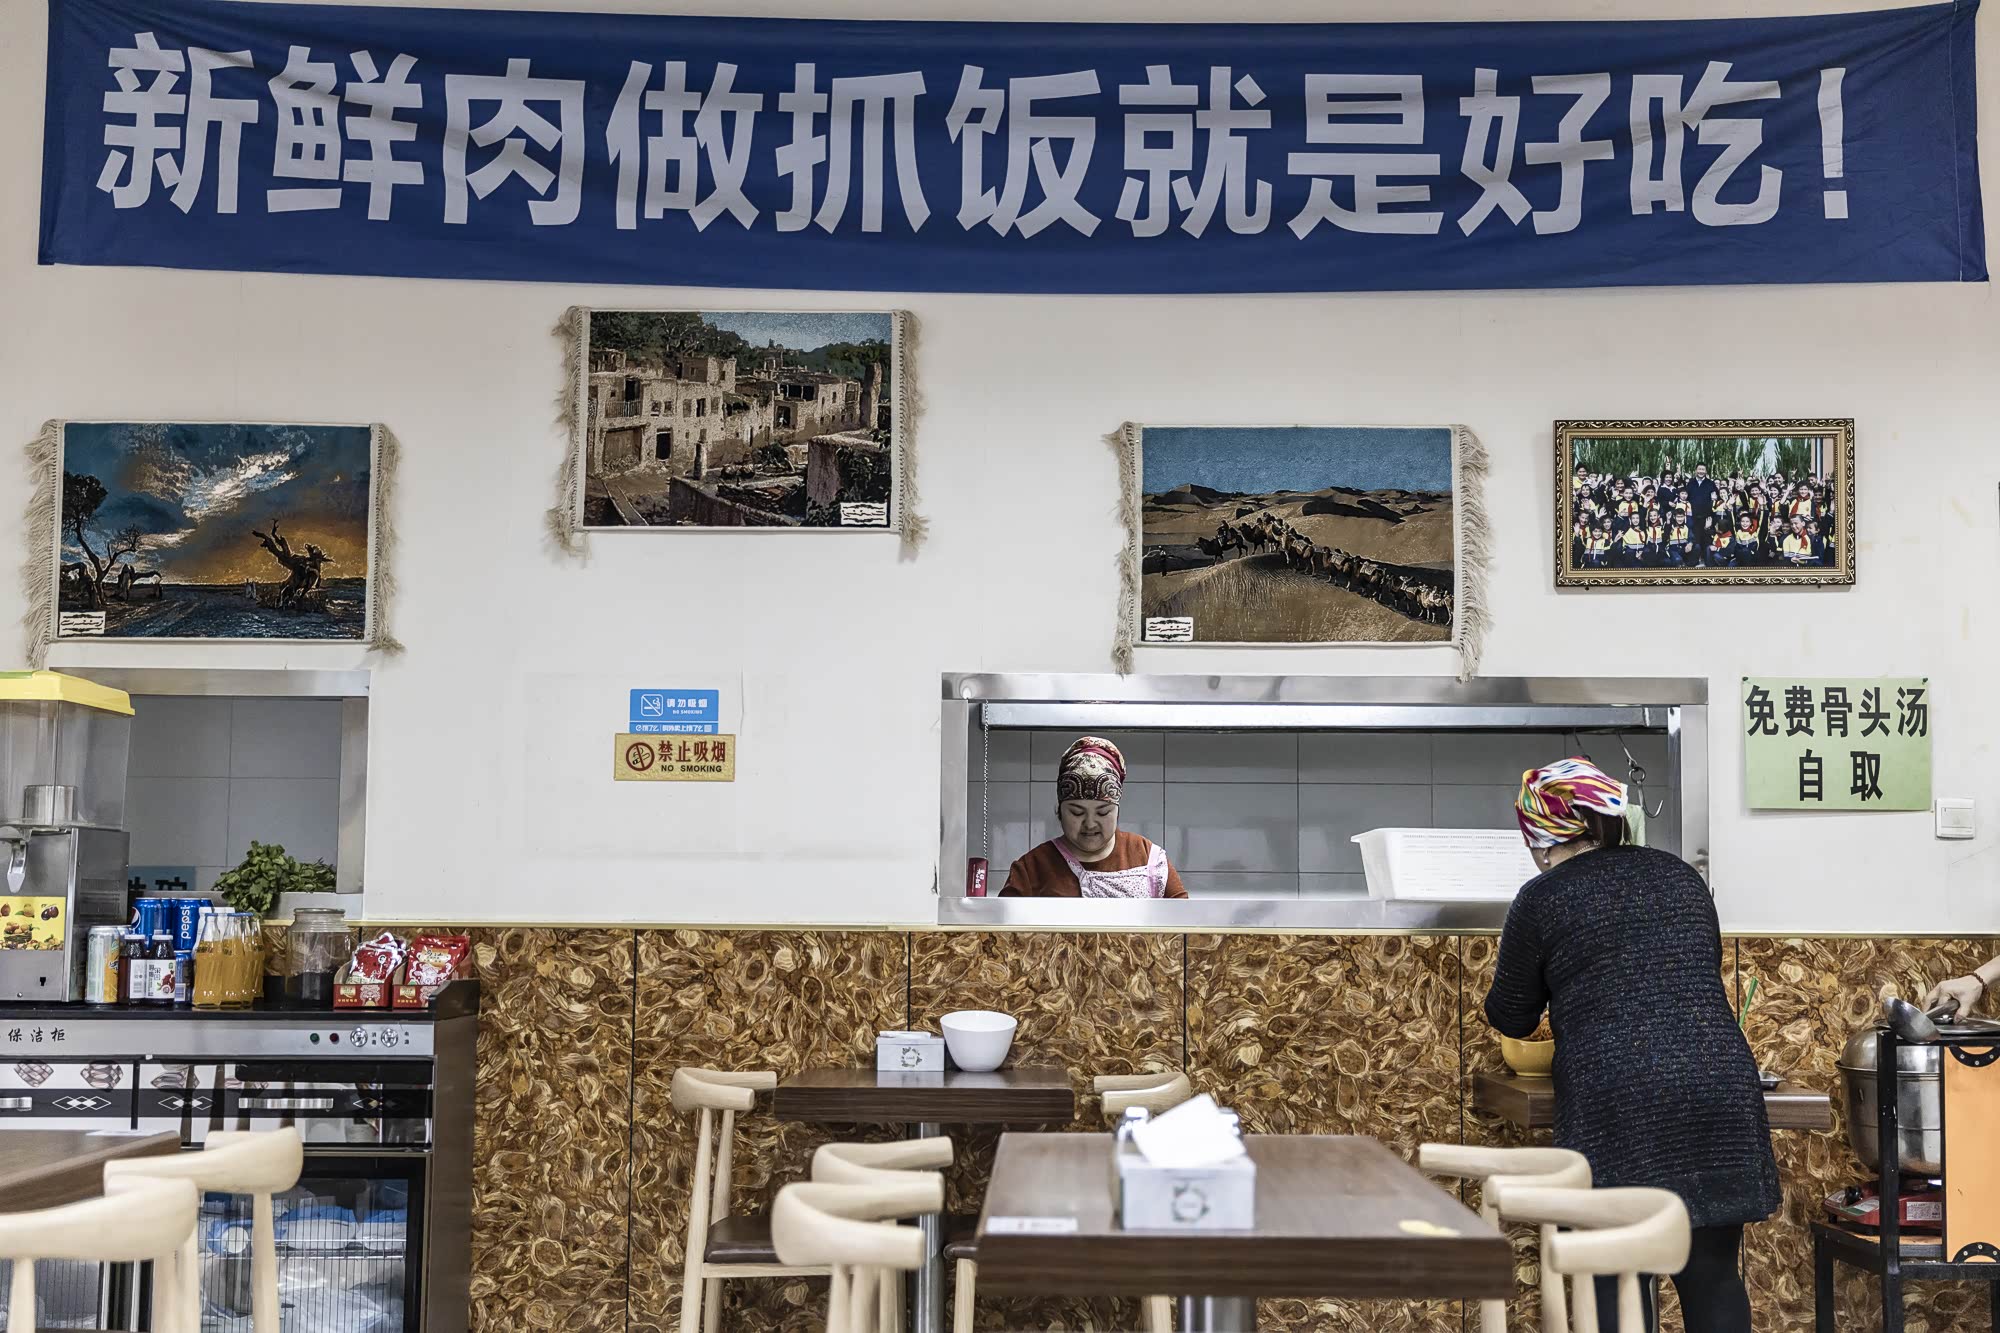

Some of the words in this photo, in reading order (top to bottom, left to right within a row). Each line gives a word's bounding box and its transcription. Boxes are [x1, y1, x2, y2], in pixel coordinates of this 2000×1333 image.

[97, 31, 1848, 240] 新鲜肉做抓饭就是好吃！
[1745, 684, 1928, 738] 免费骨头汤
[658, 740, 726, 763] 禁止吸烟
[661, 764, 674, 772] NO
[680, 764, 722, 773] SMOKING
[1799, 748, 1884, 802] 自取
[8, 1026, 66, 1043] 保洁柜
